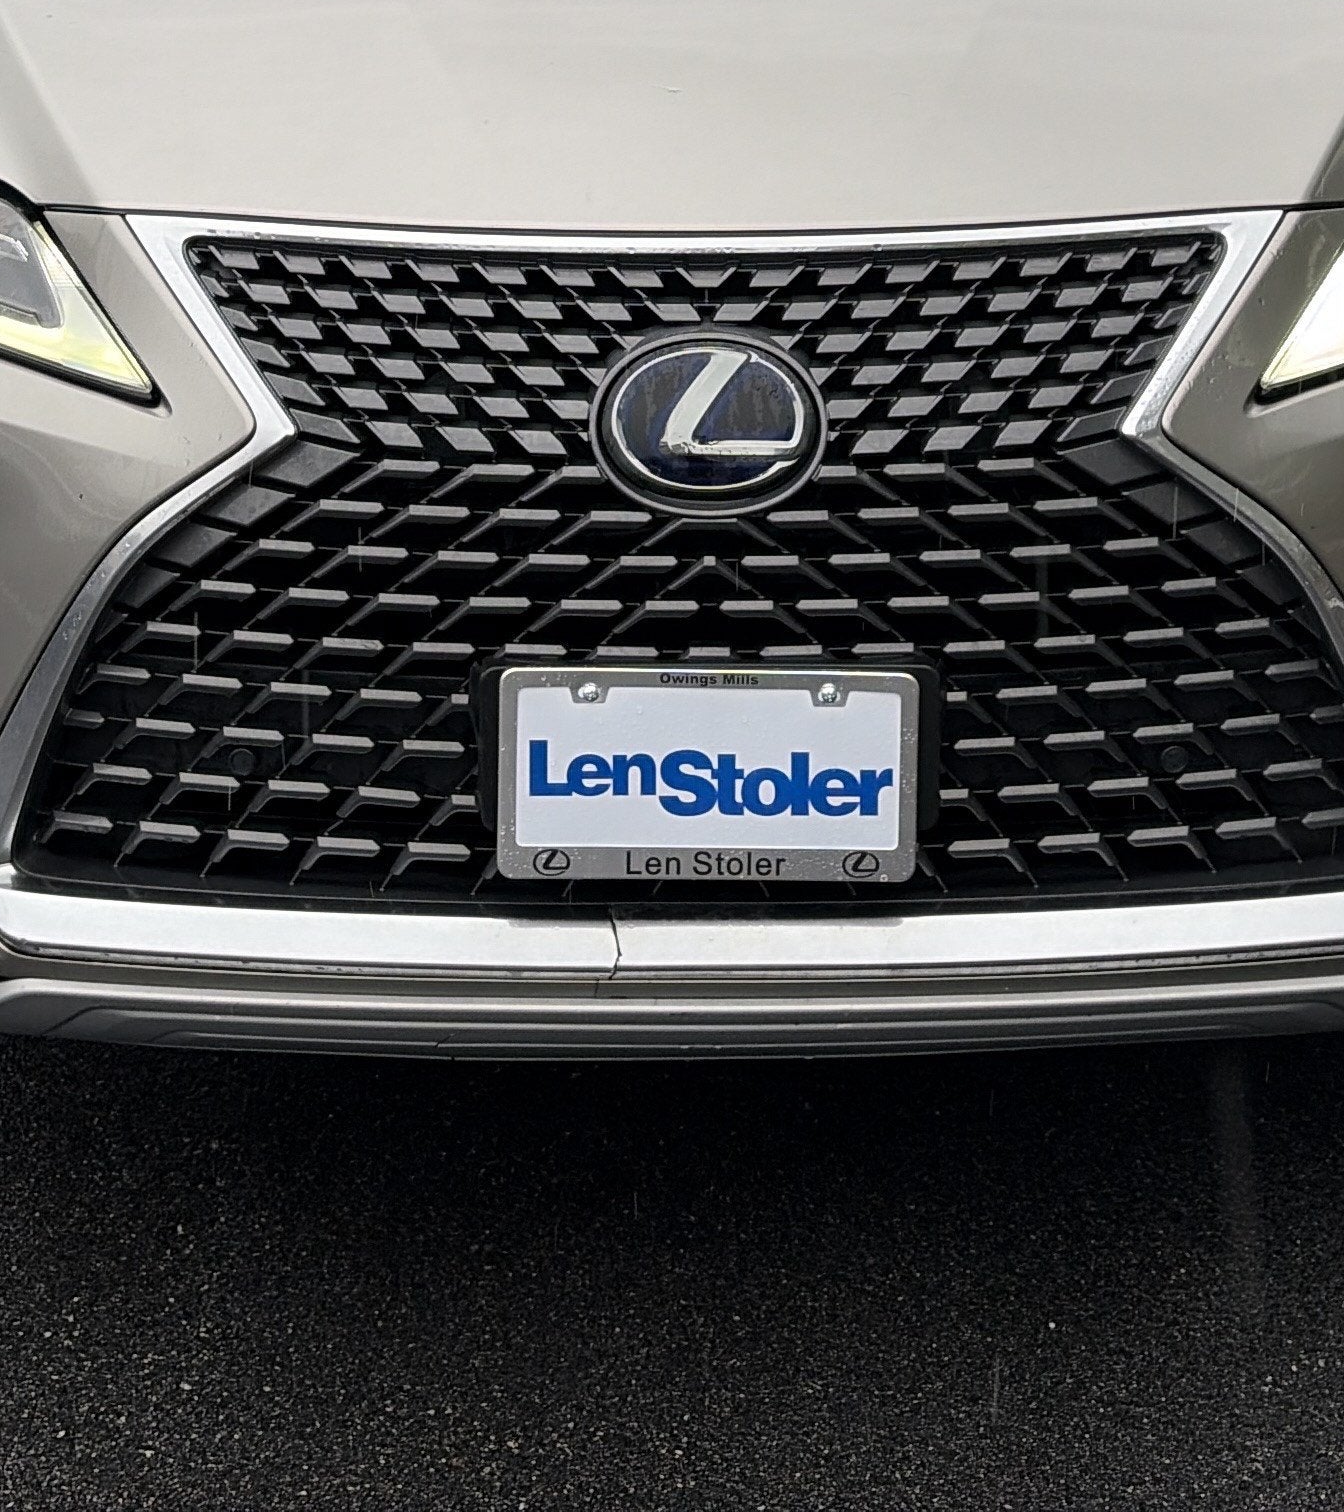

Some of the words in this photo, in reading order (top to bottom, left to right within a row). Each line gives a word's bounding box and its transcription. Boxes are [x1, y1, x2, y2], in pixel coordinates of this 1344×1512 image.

[659, 672, 717, 686] Owings
[722, 674, 759, 685] Mills
[626, 850, 681, 875] Len
[692, 851, 787, 876] Stoler
